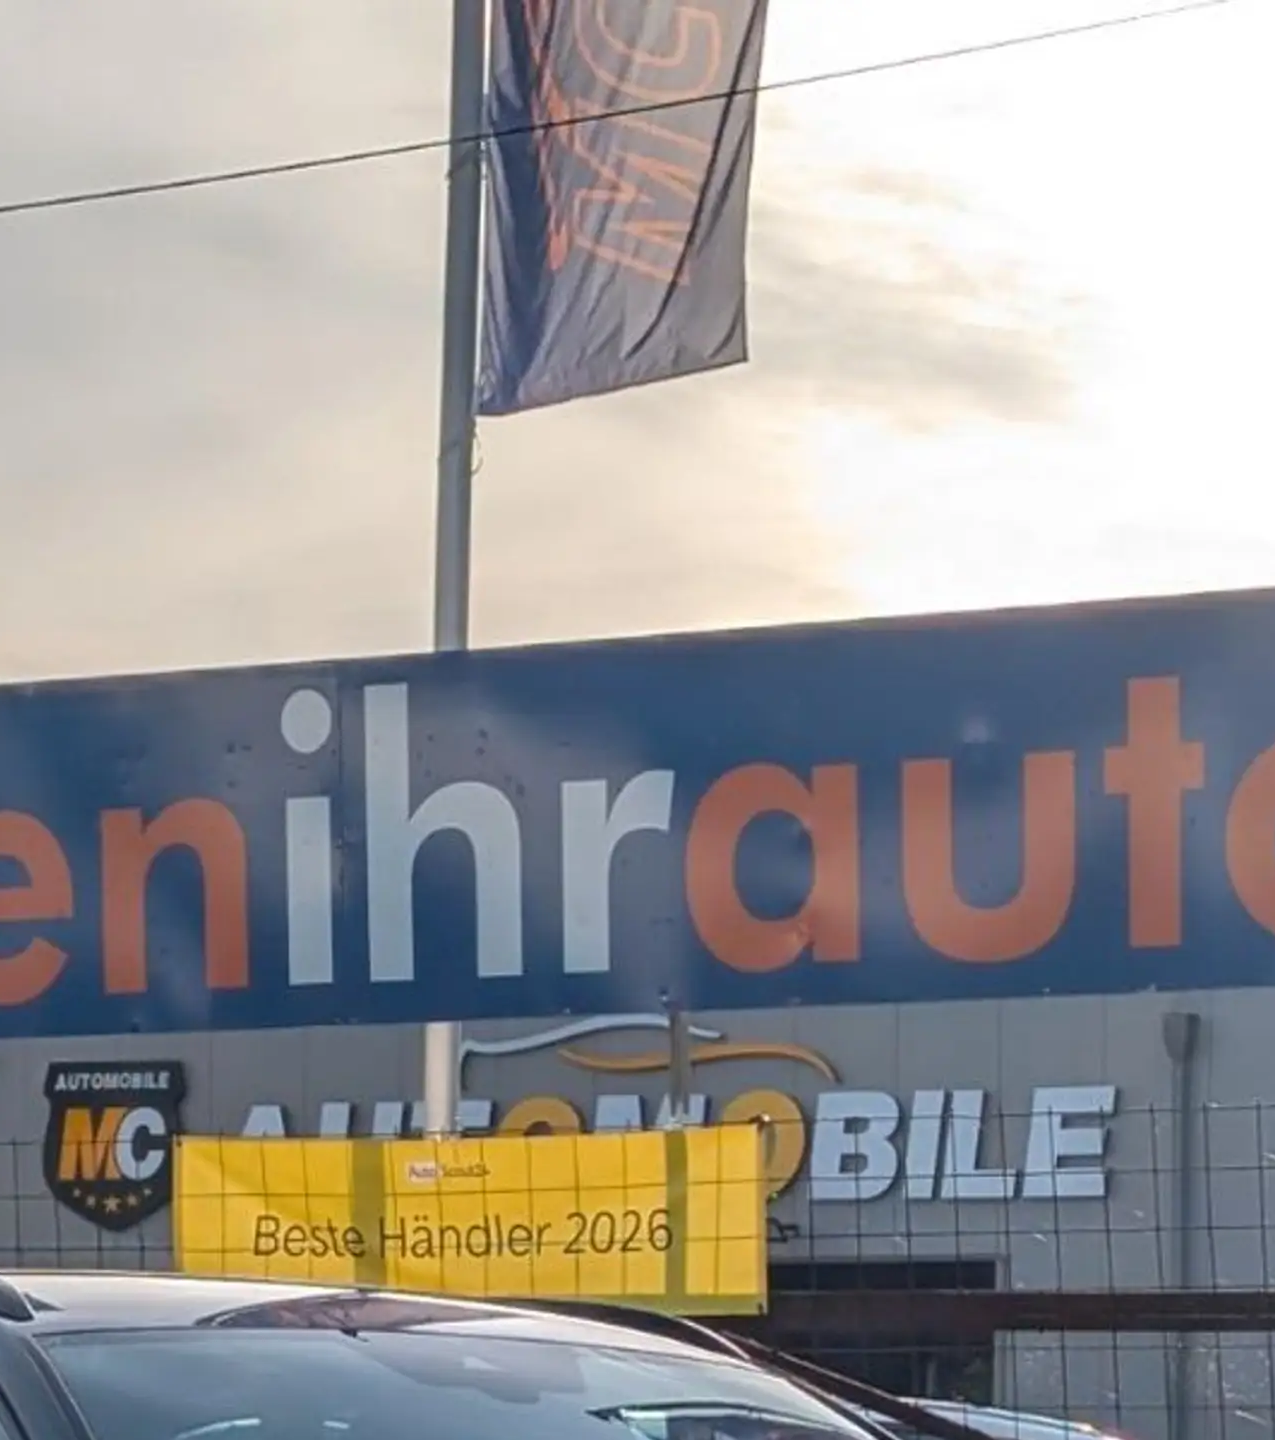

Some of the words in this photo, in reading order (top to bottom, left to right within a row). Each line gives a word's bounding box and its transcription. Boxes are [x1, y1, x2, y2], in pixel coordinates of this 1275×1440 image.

[54, 1070, 171, 1091] AUTOMOBILE
[58, 1106, 167, 1181] MC
[252, 1214, 366, 1258] Beste
[379, 1213, 551, 1259] Händler
[563, 1209, 674, 1254] 2026
